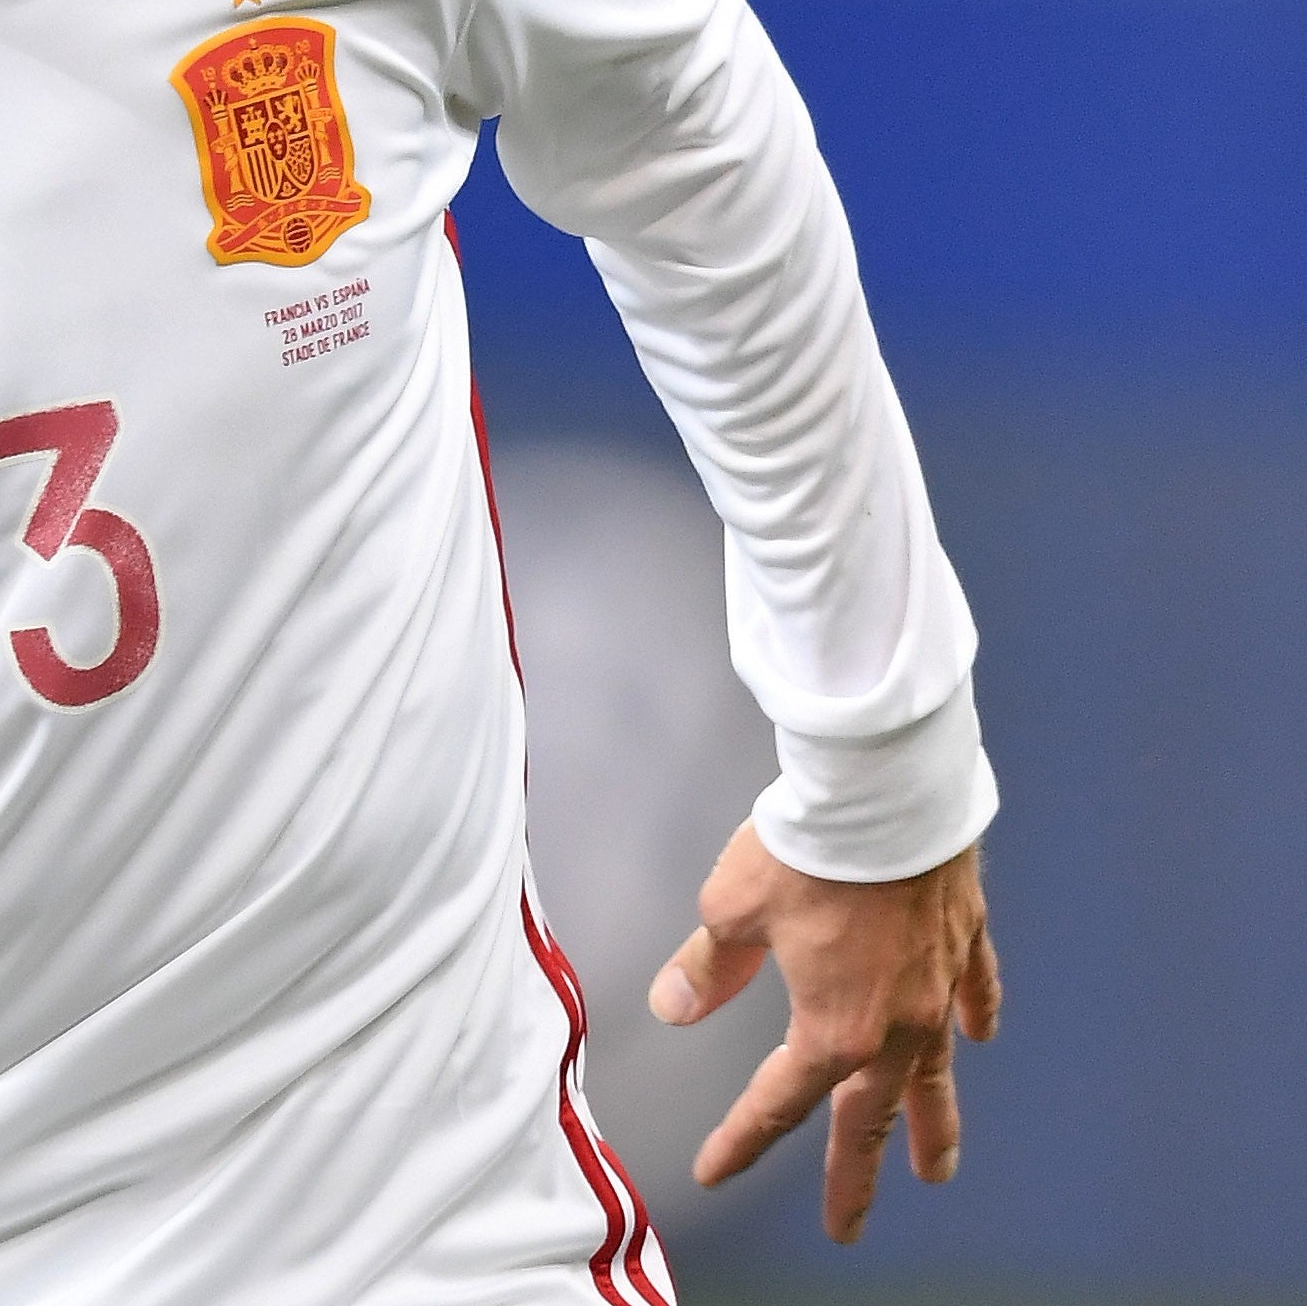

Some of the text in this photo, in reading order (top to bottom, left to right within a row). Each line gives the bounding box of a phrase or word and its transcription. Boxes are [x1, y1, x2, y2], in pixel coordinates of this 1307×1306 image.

[264, 278, 370, 327] FRANCIA VS ESPAÑA
[282, 302, 363, 344] 28 MARZO 2017
[281, 320, 370, 367] STADE DE FRANCE
